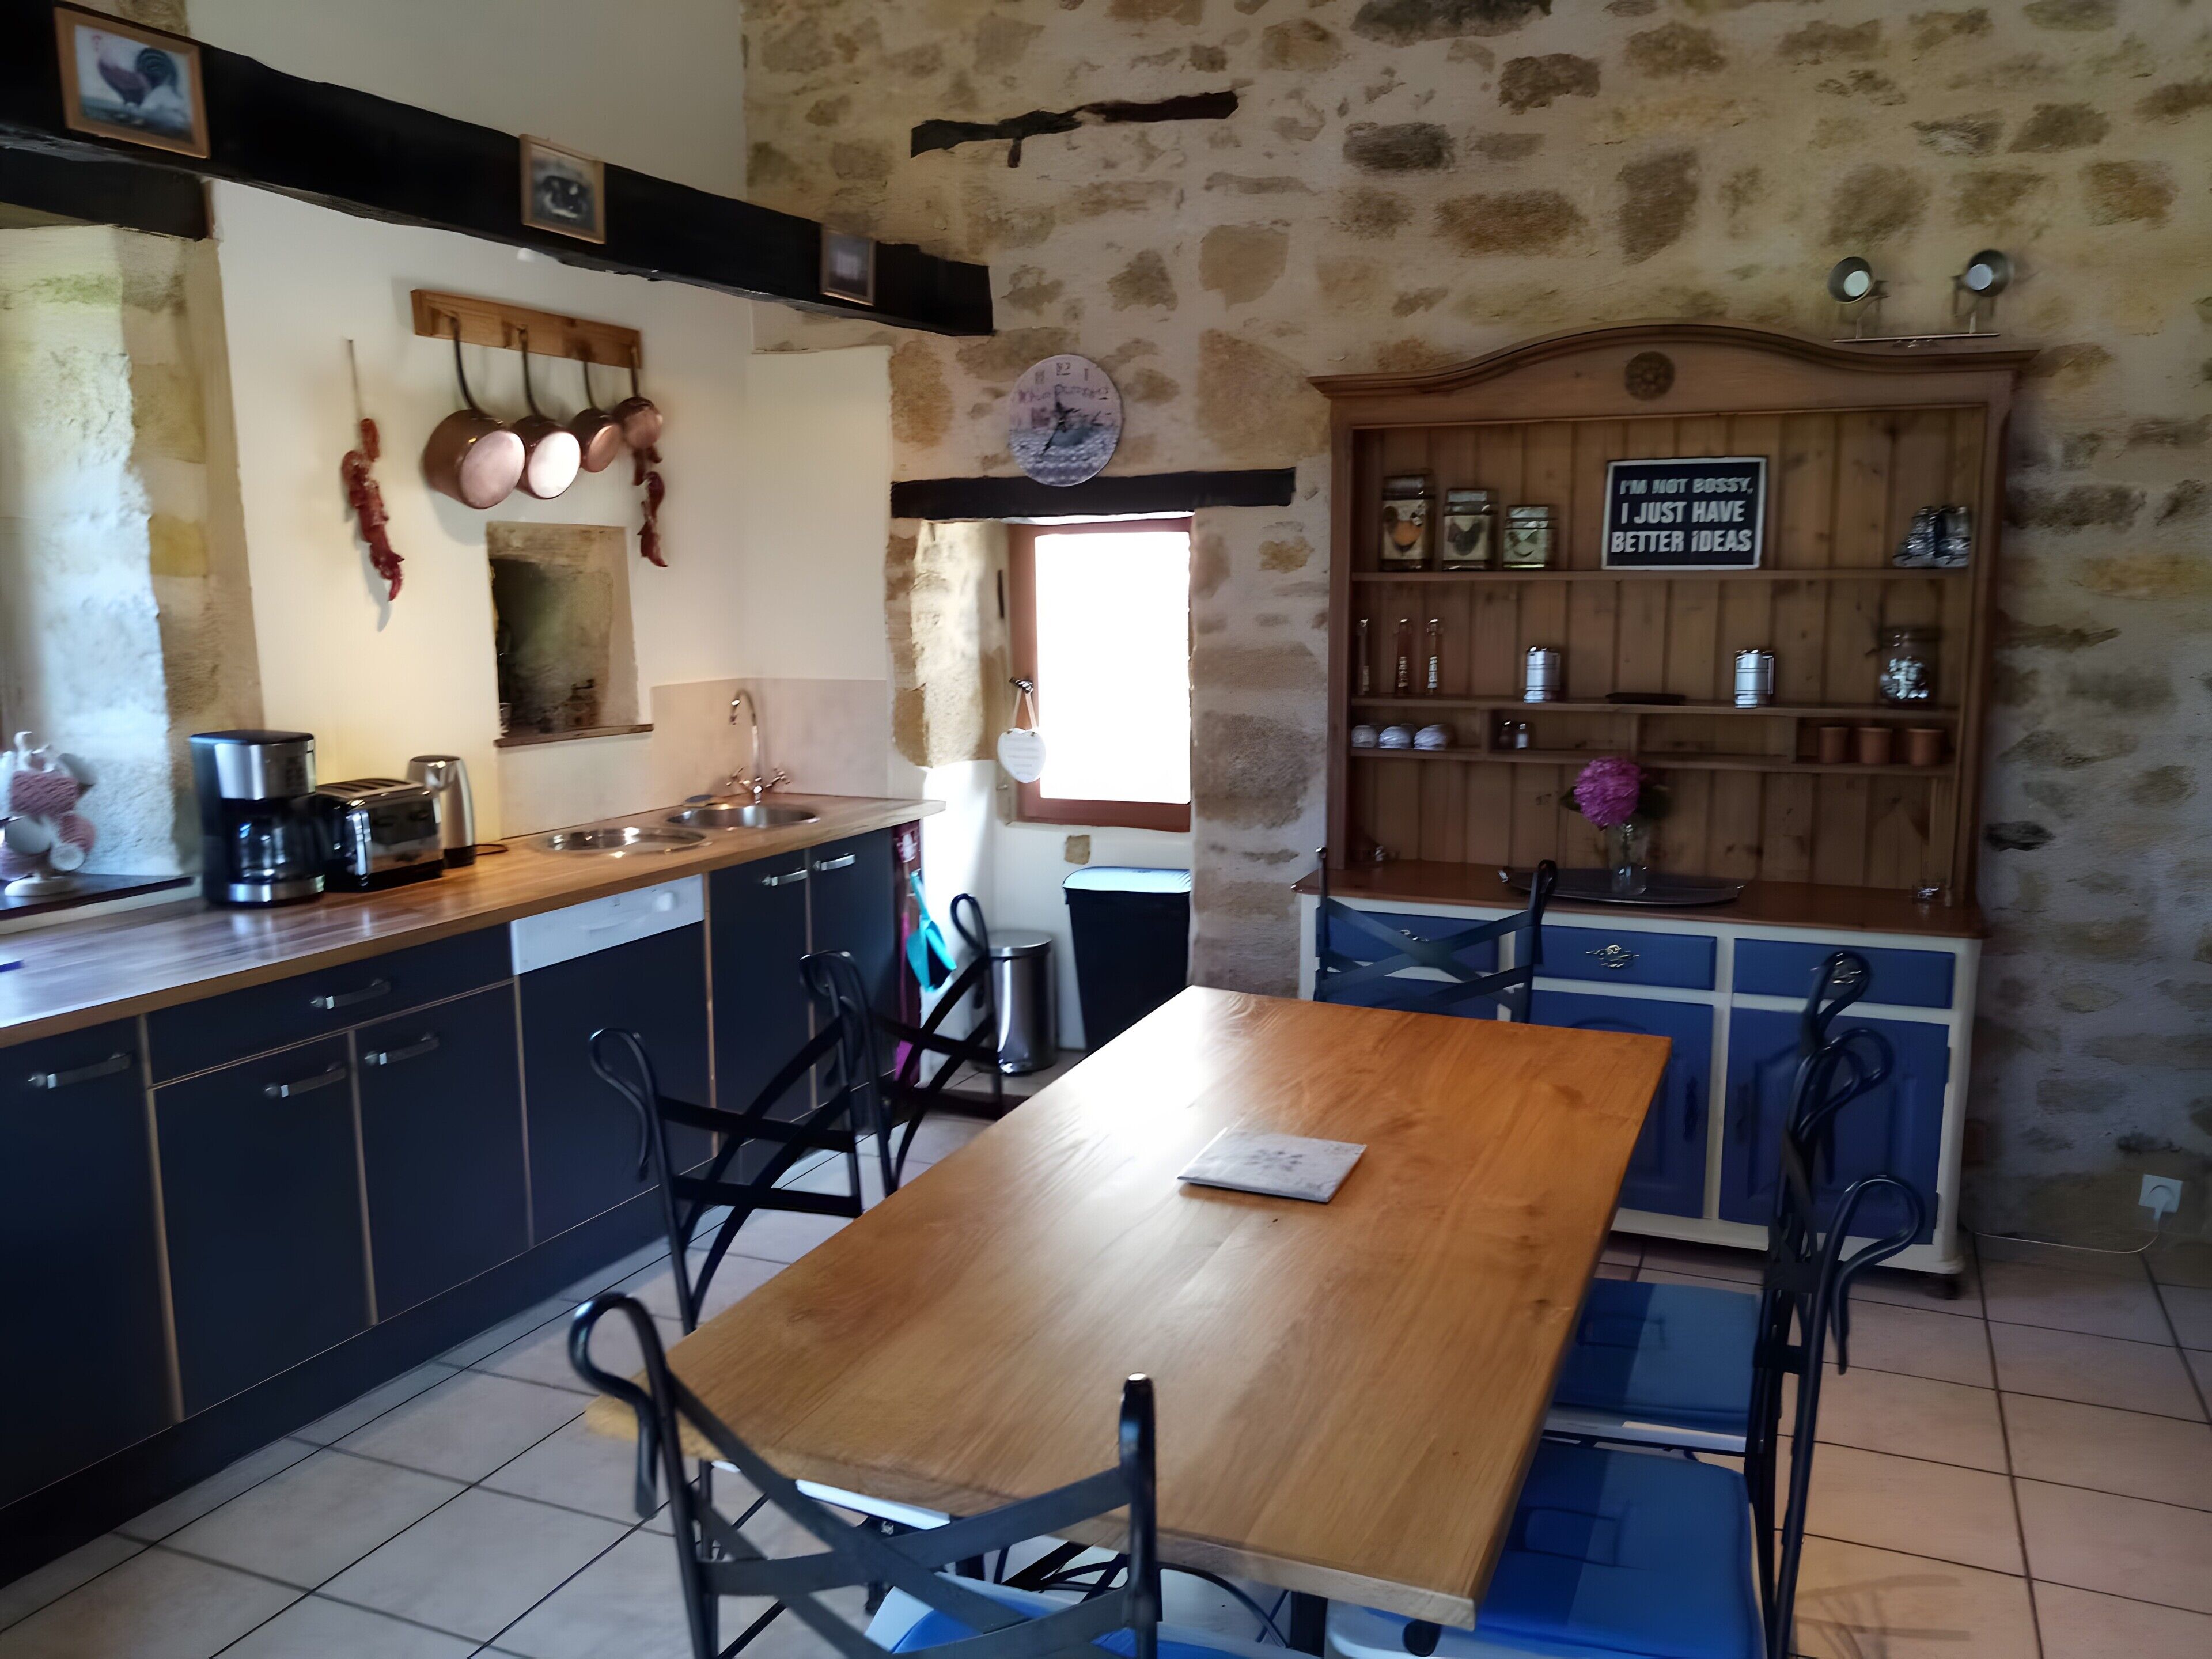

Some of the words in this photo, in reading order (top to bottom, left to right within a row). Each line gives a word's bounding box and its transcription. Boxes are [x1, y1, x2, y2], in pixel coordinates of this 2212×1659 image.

[1620, 479, 1648, 495] I'M
[1652, 478, 1689, 494] NOT
[1622, 503, 1628, 524] I
[1634, 501, 1687, 524] JUST
[1691, 500, 1746, 523] HAVE
[1611, 530, 1684, 553] BETTER
[1691, 529, 1753, 552] IDEAS
